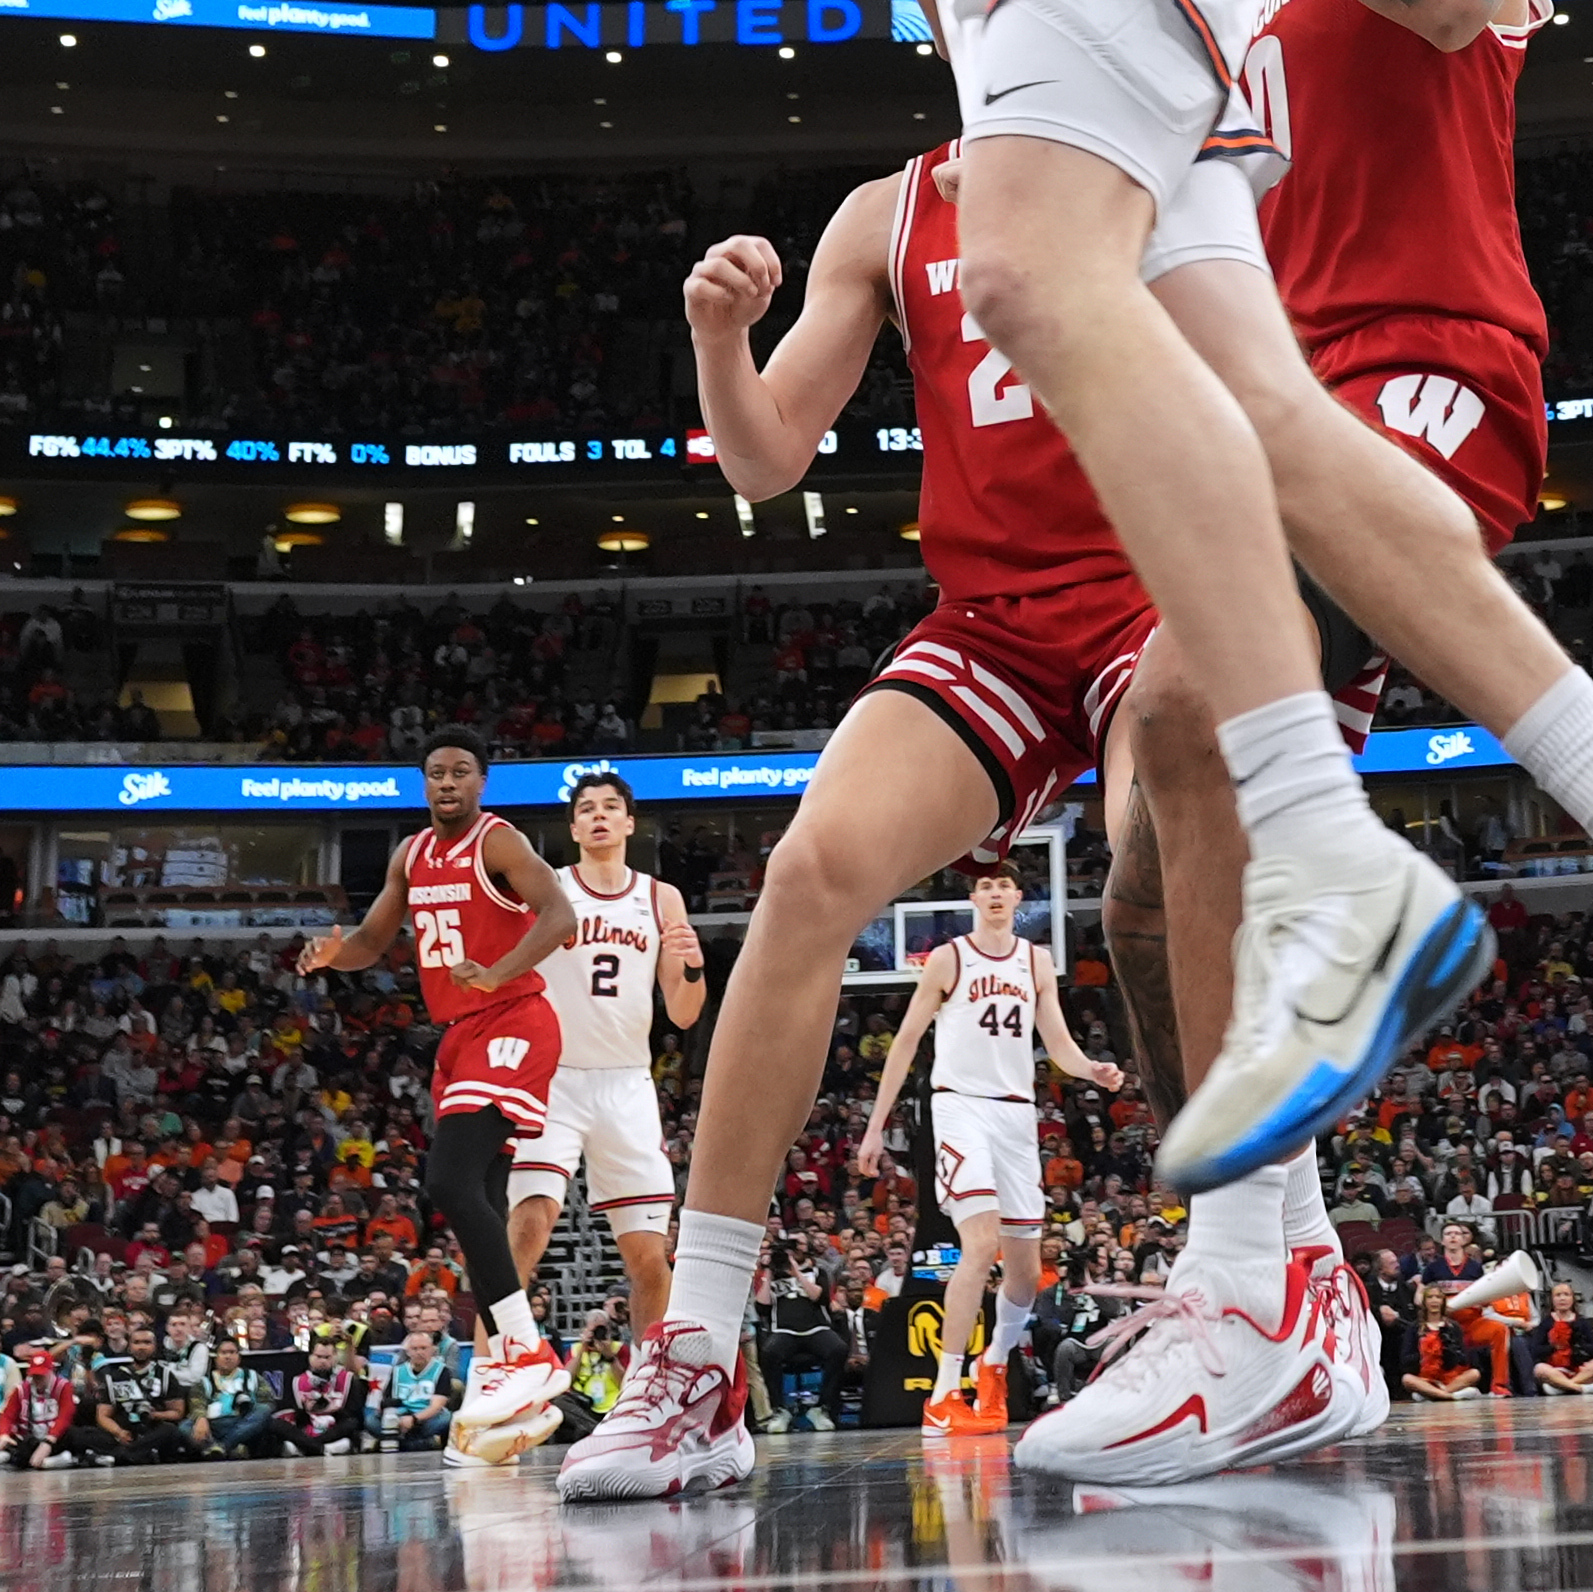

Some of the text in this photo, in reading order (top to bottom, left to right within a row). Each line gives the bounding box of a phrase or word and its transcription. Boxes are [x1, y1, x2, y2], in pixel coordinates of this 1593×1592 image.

[961, 311, 1034, 428] 2
[1375, 373, 1485, 460] W
[29, 436, 80, 457] FG%
[81, 437, 151, 458] 44.4%
[154, 438, 217, 461] 3PT%
[226, 441, 280, 462] 40%
[288, 441, 336, 464] FT%
[350, 443, 390, 464] 0%
[405, 444, 477, 466] BONUS
[510, 442, 576, 464] FOULS
[586, 440, 603, 461] 3
[659, 438, 677, 457] 4
[1426, 730, 1477, 766] Silk
[118, 770, 175, 806] Silk
[241, 777, 400, 801] Feel planty good.
[415, 908, 466, 969] 25
[590, 954, 621, 997] 2
[968, 974, 1029, 1003] Illinois
[979, 1003, 1023, 1038] 44
[486, 1036, 530, 1071] W
